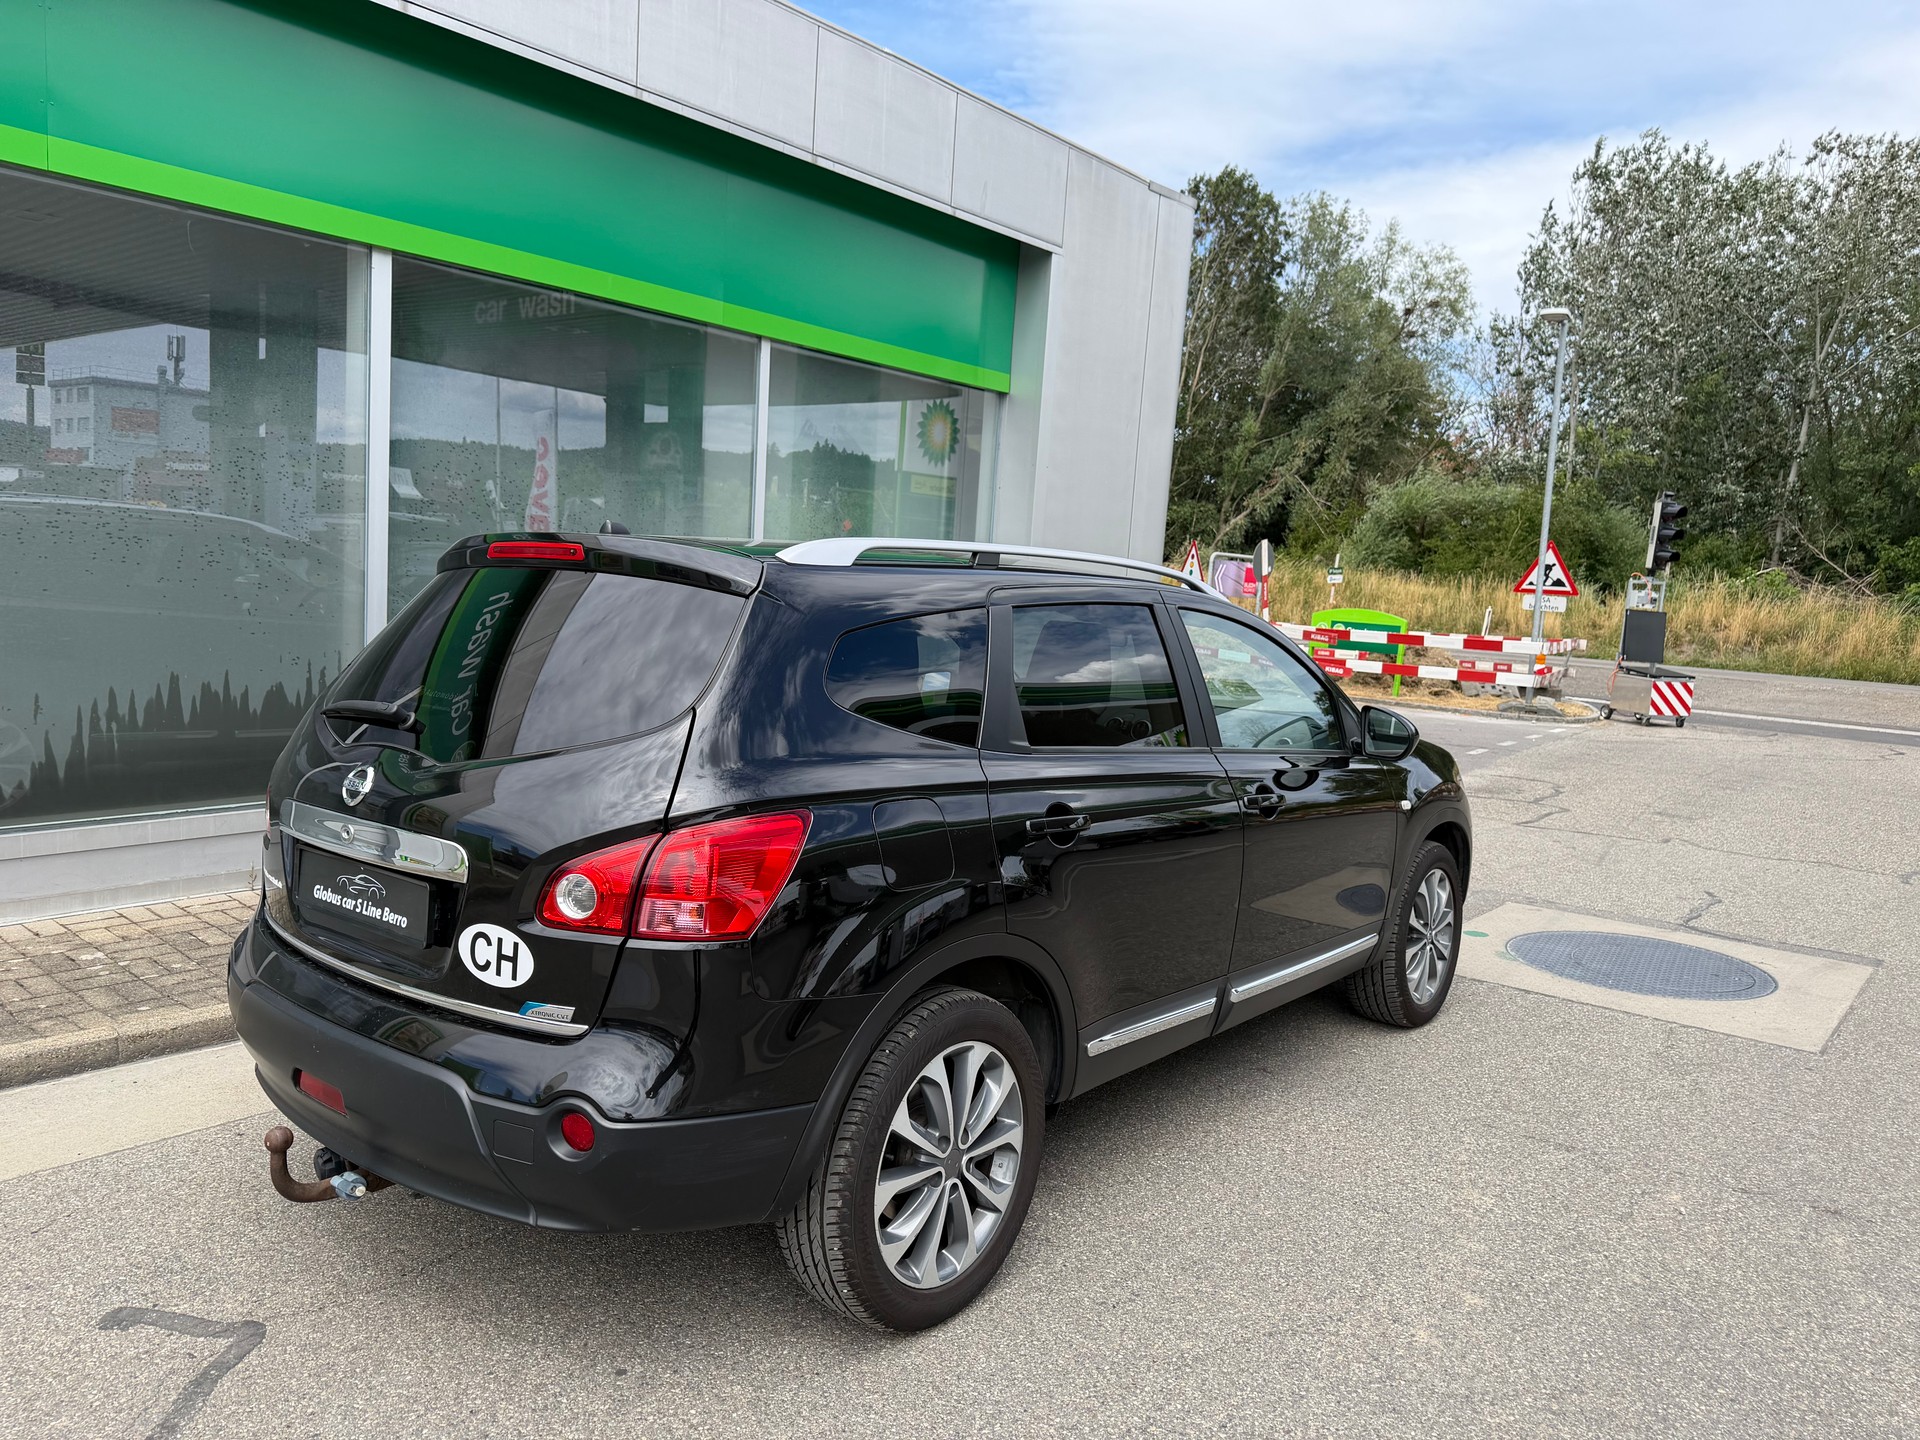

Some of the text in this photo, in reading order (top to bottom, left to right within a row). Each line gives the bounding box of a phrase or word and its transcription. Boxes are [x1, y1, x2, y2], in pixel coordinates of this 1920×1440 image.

[475, 290, 576, 323] car wash
[1311, 633, 1329, 642] KIBAG
[1325, 666, 1344, 674] KIBAG
[313, 884, 408, 928] Globus car S Line Berro
[470, 931, 519, 981] CH
[530, 1010, 556, 1019] XTRONIC
